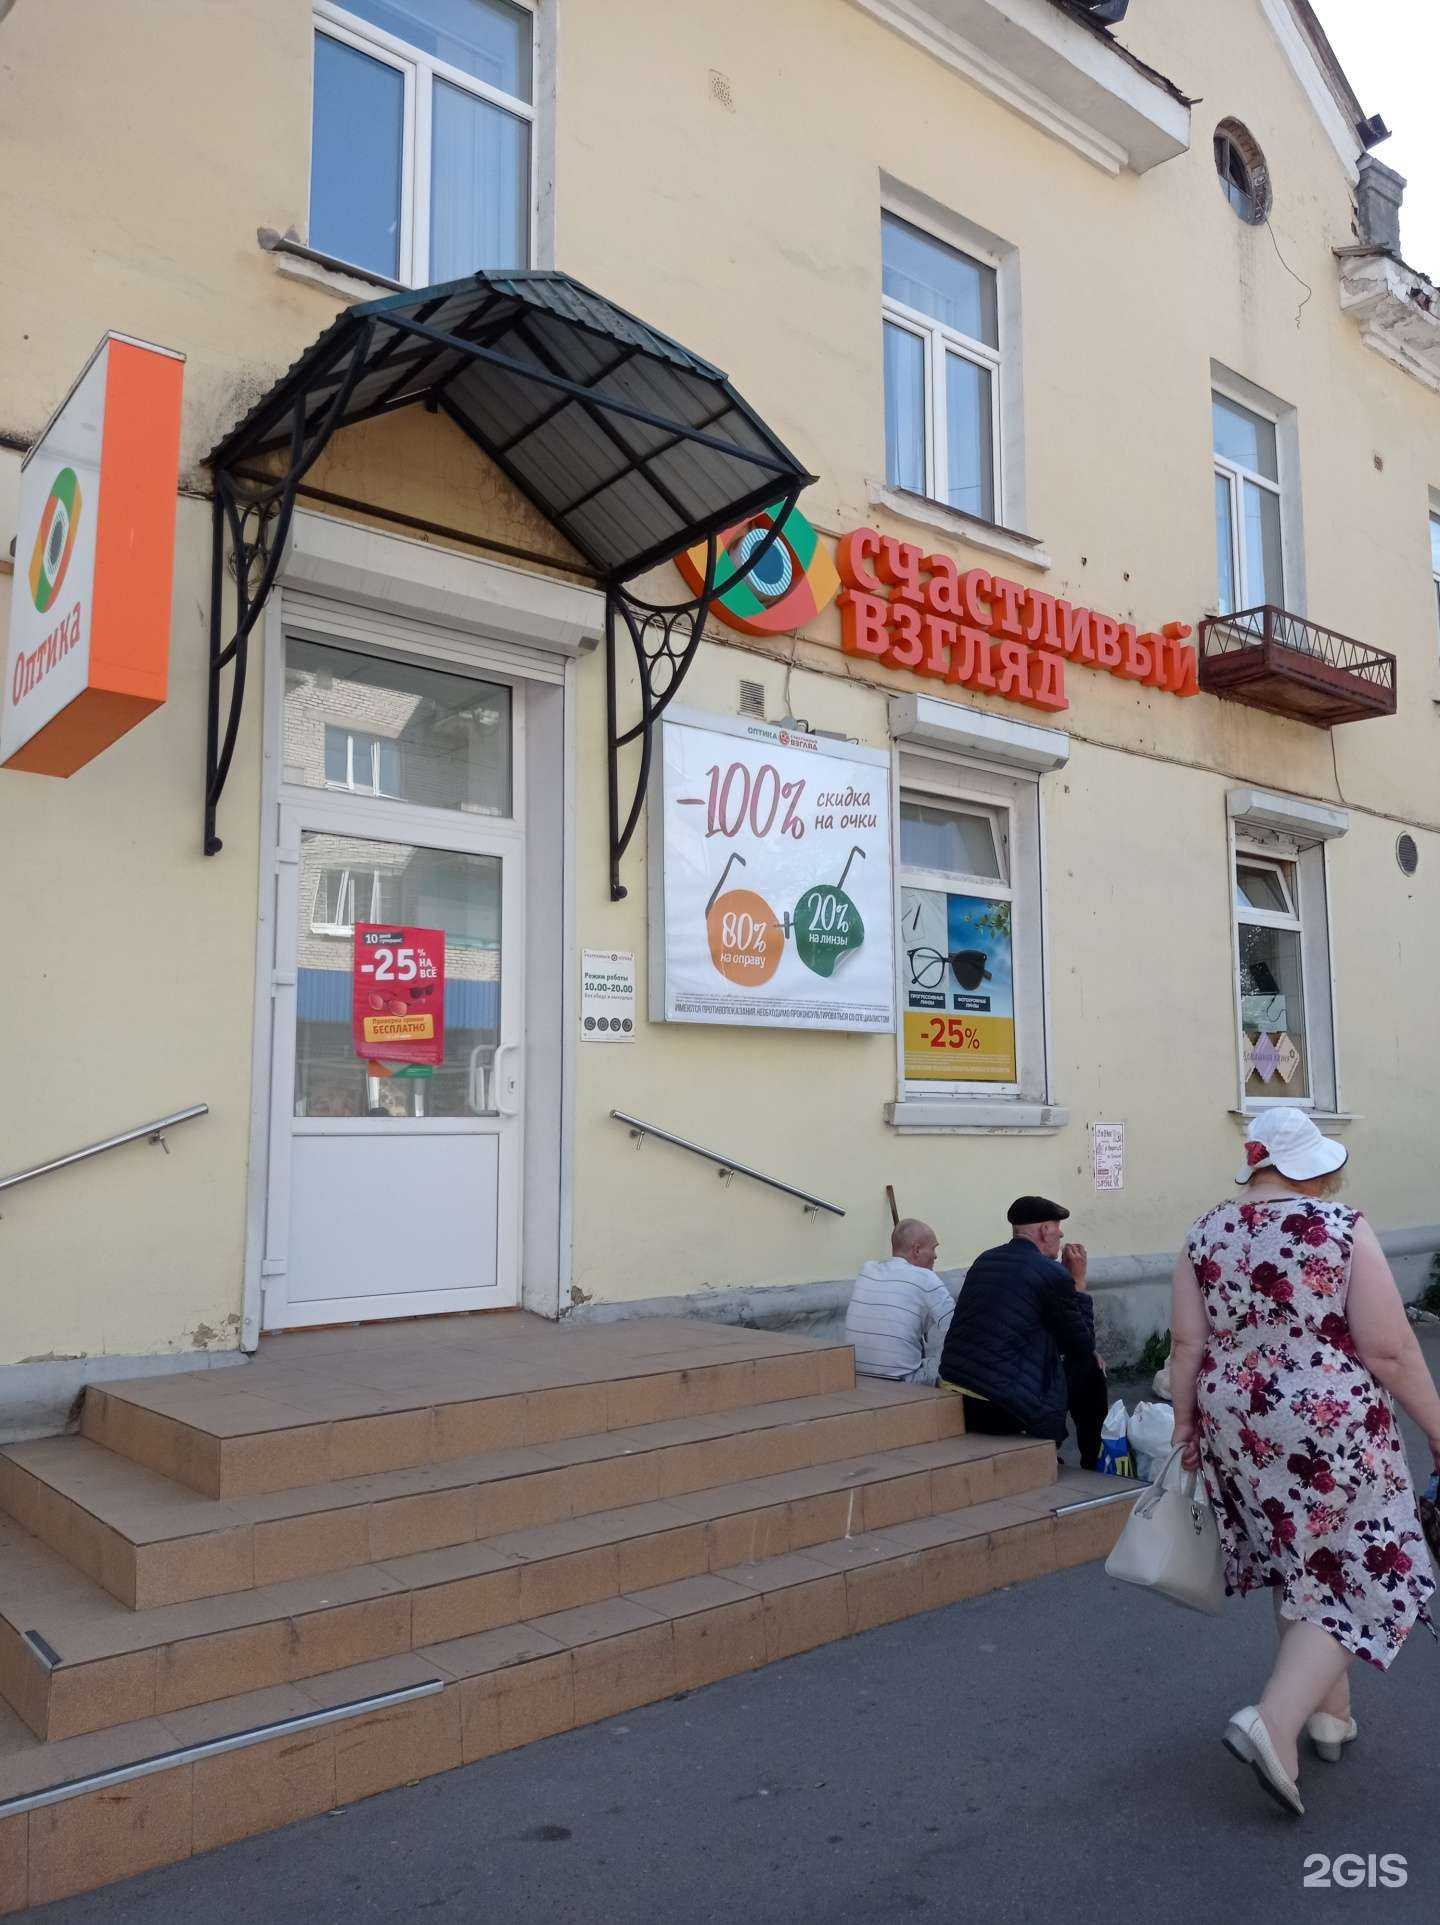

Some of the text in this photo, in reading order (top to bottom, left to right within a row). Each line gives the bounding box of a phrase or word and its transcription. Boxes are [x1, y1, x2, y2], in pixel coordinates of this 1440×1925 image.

[13, 601, 80, 706] Оптика
[676, 762, 806, 839] -100%
[816, 786, 871, 807] скидка
[815, 814, 877, 830] на очки
[807, 892, 849, 933] 20%
[365, 933, 378, 944] 10
[722, 911, 767, 952] 80%
[808, 932, 848, 946] на линзы
[419, 958, 432, 968] НА
[720, 952, 766, 969] на оправу
[607, 974, 629, 983] работы
[584, 982, 633, 993] 10.00-20.00
[373, 1023, 425, 1034] БЕСПЛАТНО
[921, 1018, 980, 1050] -25%
